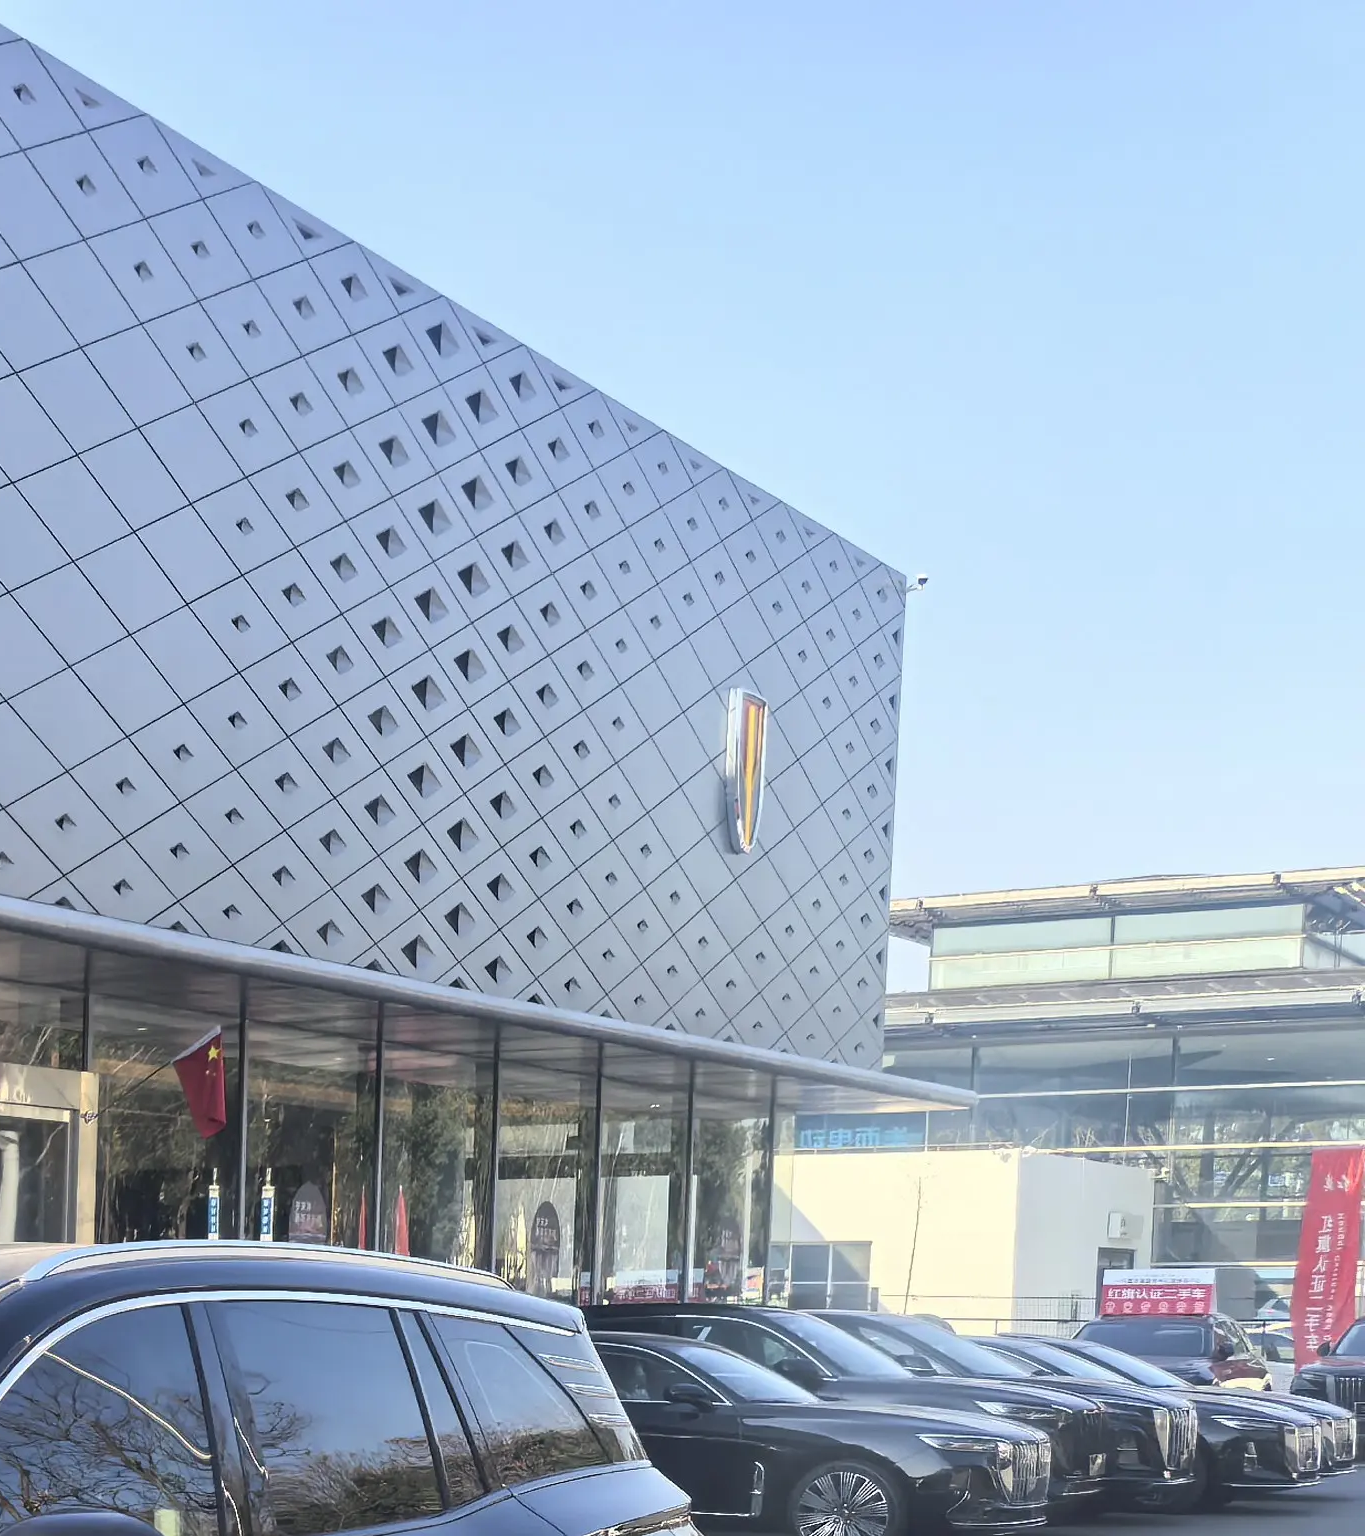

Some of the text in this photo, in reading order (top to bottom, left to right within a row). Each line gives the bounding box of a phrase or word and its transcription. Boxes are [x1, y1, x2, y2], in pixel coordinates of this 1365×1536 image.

[1107, 1288, 1207, 1300] 红旗认证二手车
